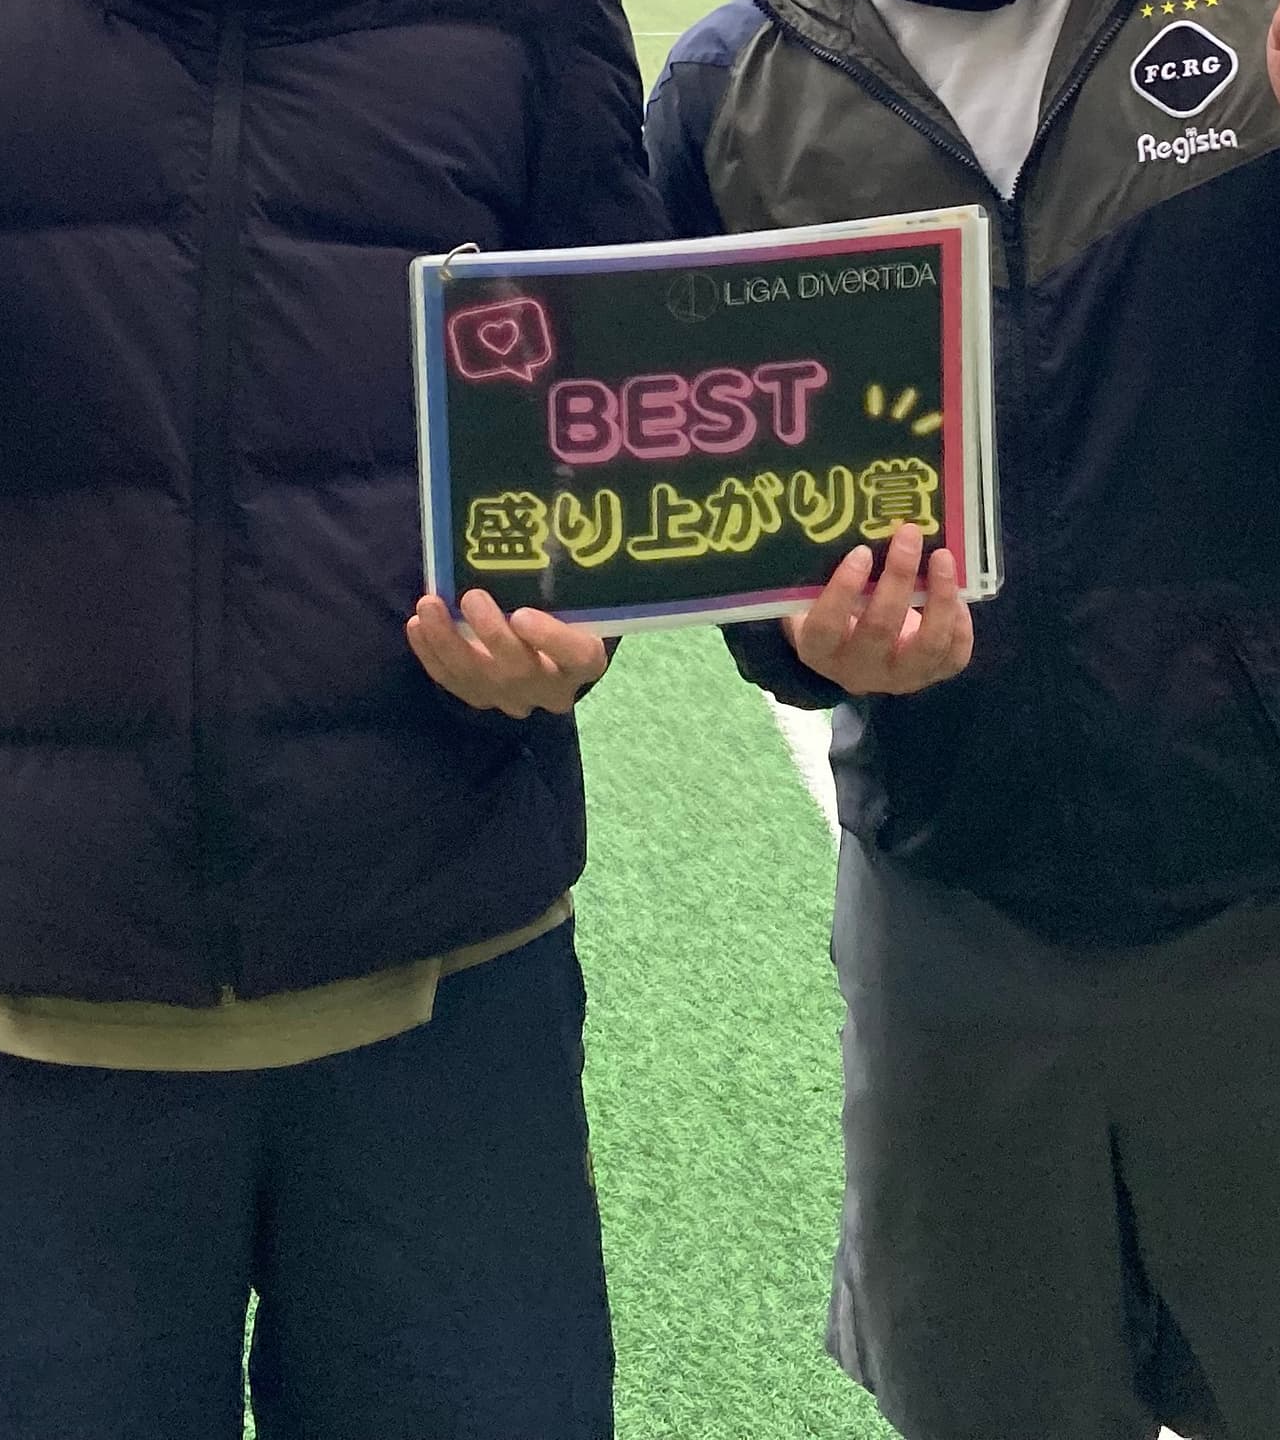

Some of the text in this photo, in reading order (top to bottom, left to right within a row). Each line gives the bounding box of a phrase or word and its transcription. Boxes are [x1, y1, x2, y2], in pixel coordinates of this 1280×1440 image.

[1144, 56, 1221, 84] FC.RG
[1137, 127, 1238, 164] Regista
[549, 361, 828, 463] BEST
[466, 457, 940, 570] 盛り上がり賞
